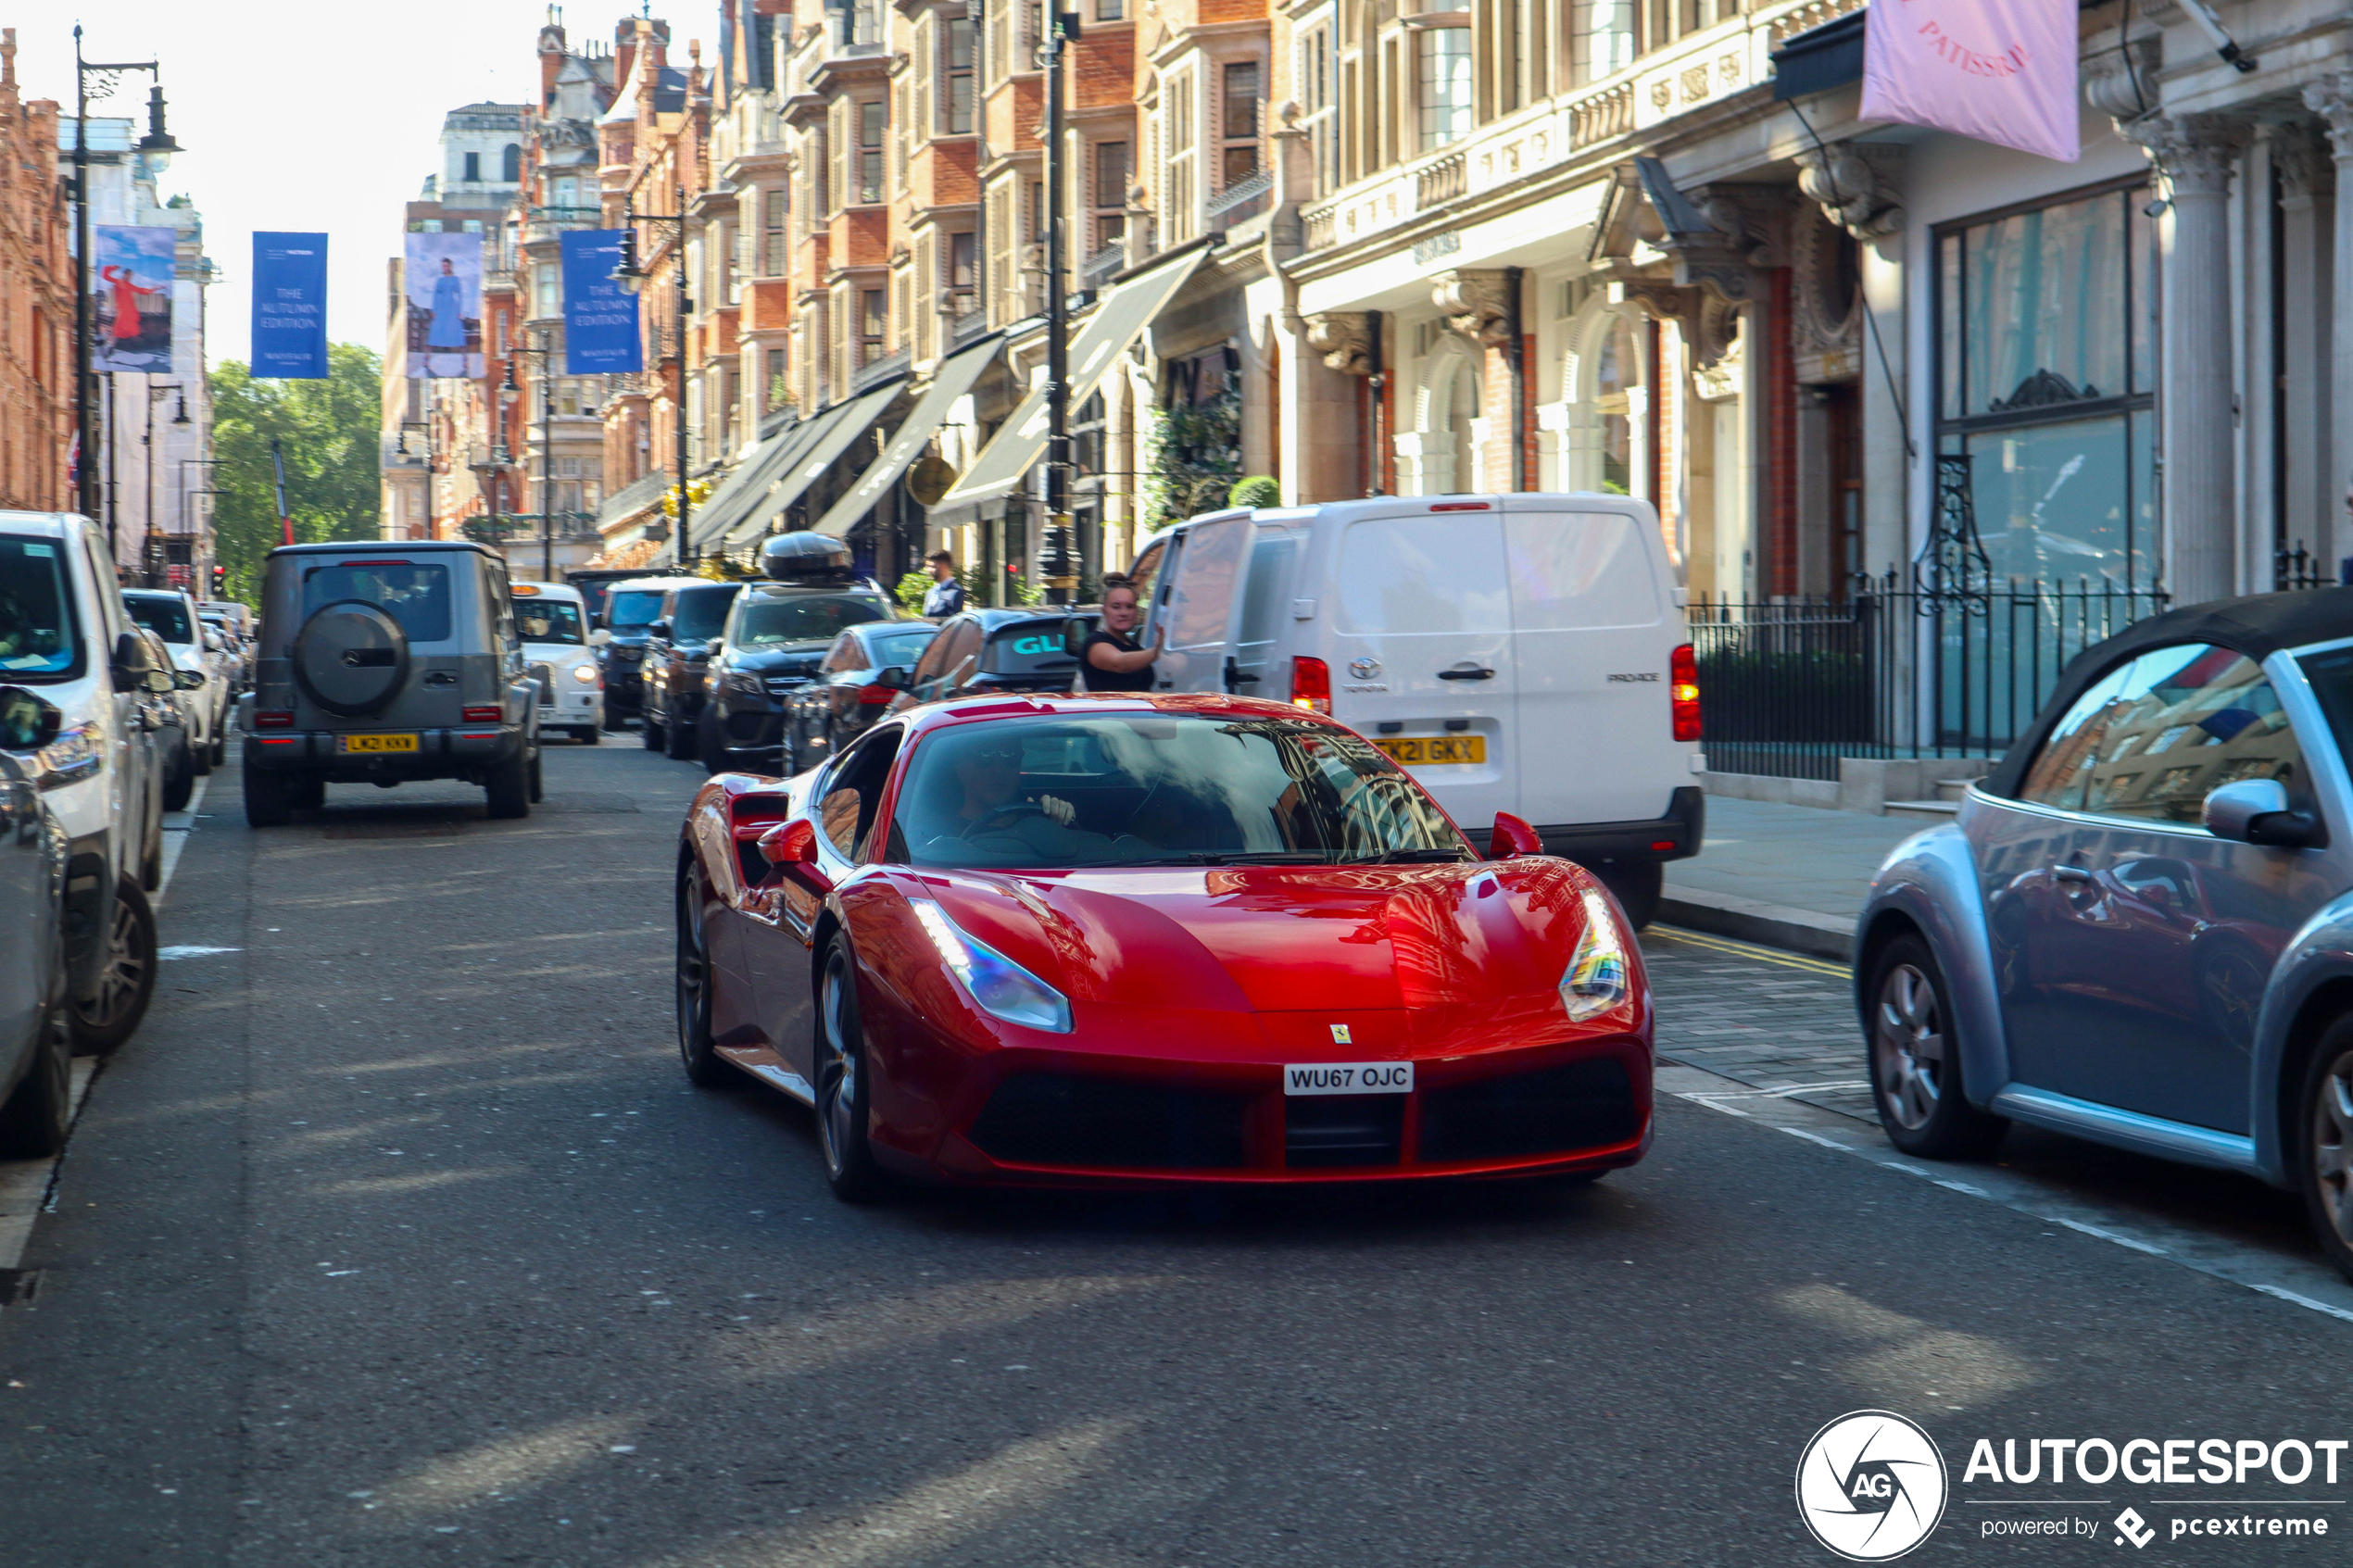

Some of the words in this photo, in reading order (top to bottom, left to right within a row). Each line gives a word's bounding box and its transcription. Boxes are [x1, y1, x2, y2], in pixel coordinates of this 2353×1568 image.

[275, 288, 304, 300] THE
[588, 285, 616, 296] THE
[261, 303, 320, 314] AUTUMN
[574, 300, 633, 312] AUTUMN
[260, 318, 318, 329] EDITION
[574, 315, 632, 326] EDITION
[1607, 672, 1660, 684] PROACE
[1342, 683, 1388, 693] TOYOTA
[1429, 740, 1474, 760] GKX
[1290, 1069, 1354, 1088] WU67
[1362, 1067, 1407, 1086] OJC
